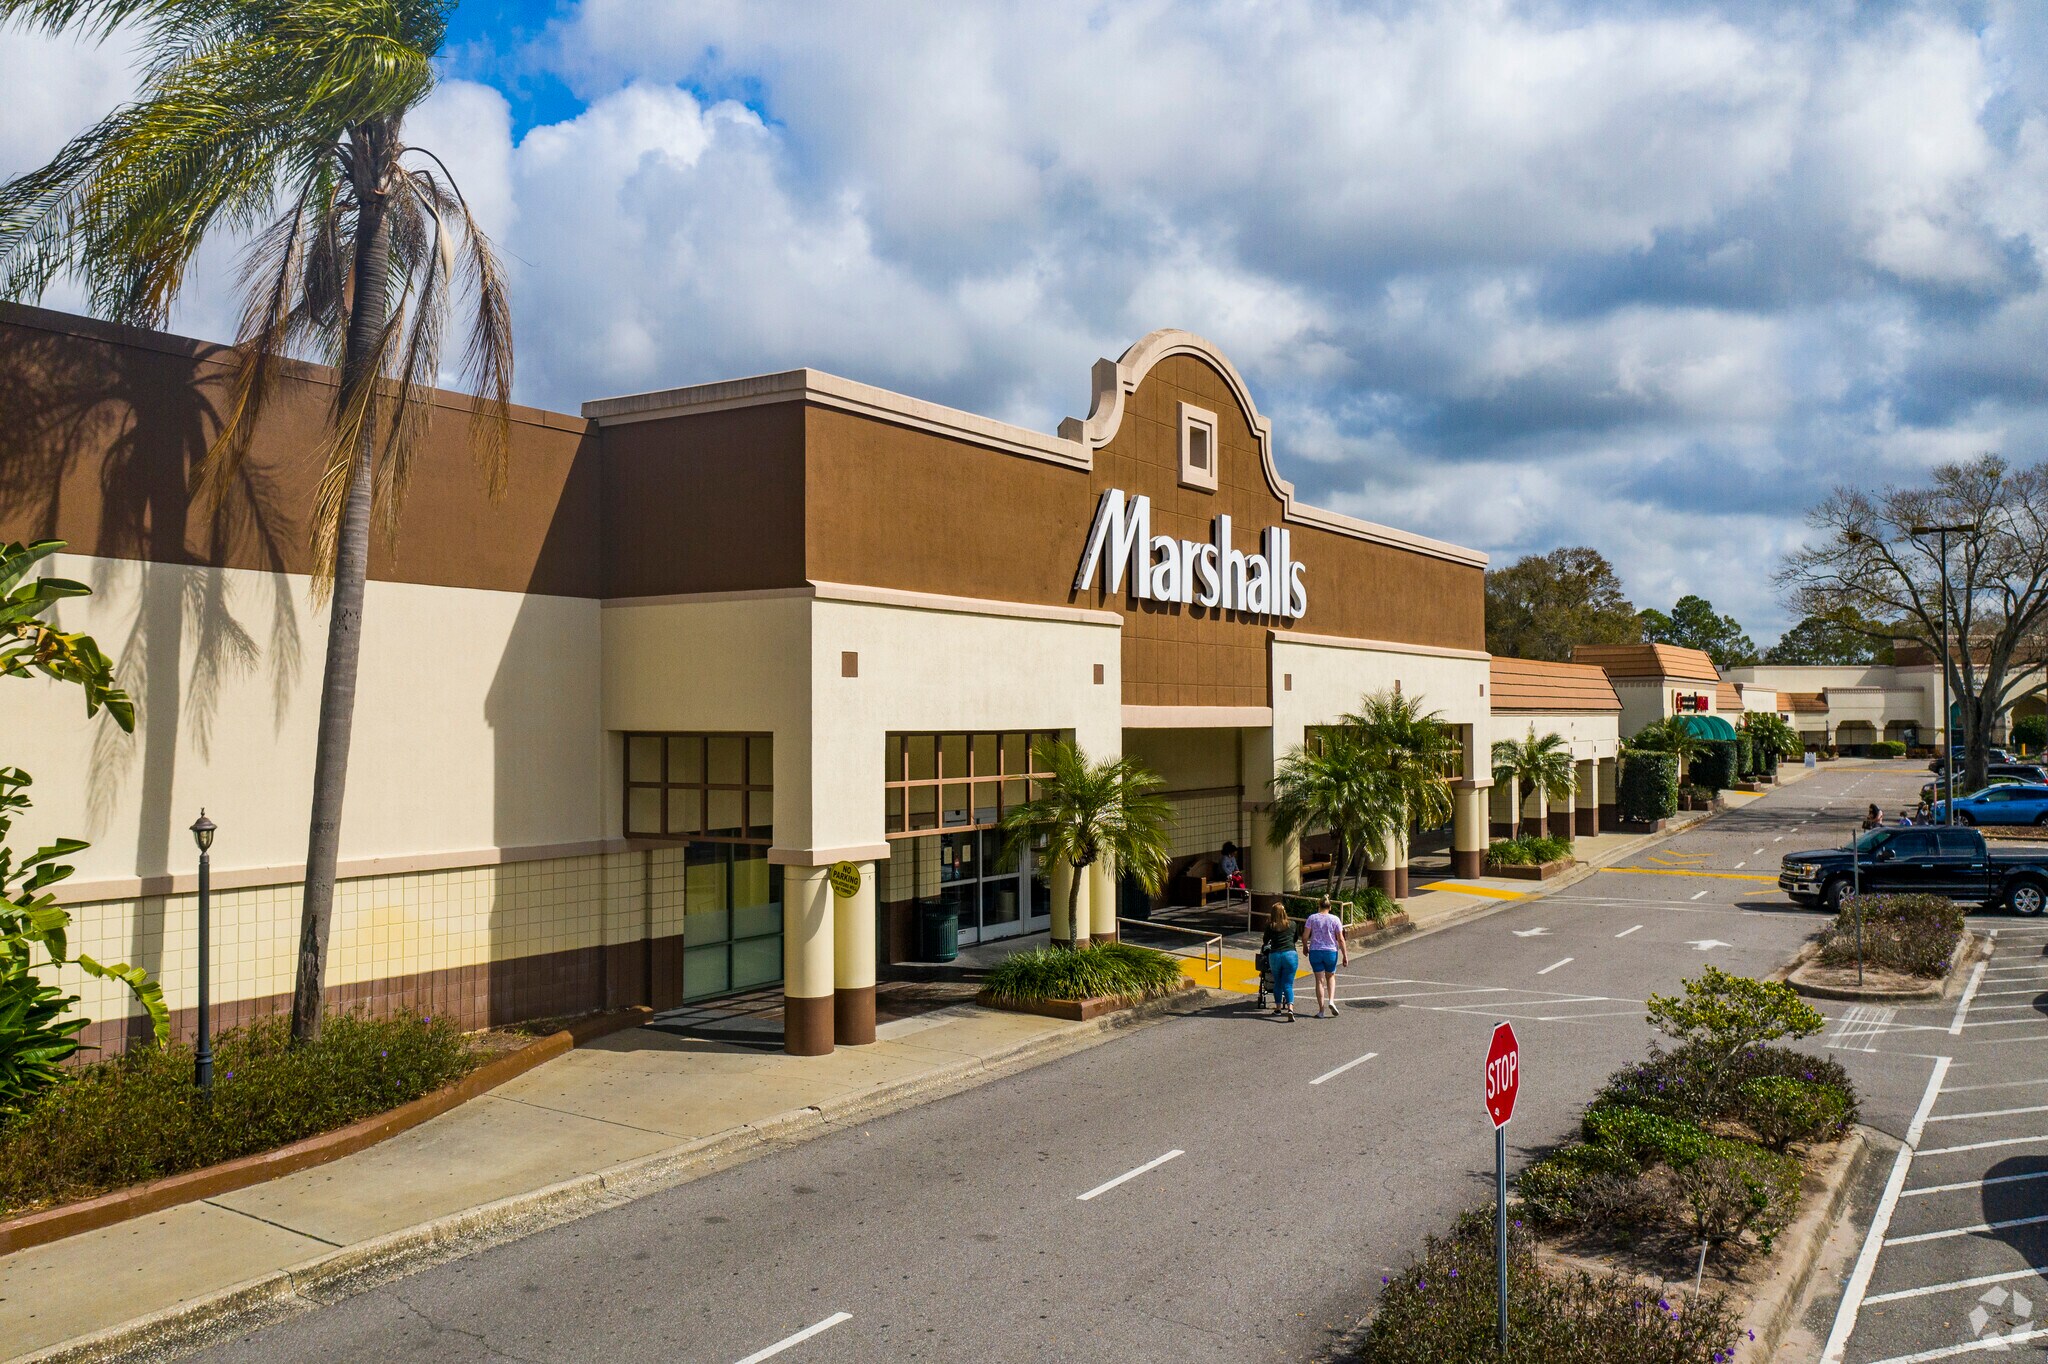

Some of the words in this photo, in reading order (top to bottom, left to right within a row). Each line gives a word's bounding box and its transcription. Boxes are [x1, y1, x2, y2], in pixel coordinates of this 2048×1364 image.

[1077, 488, 1307, 619] Marshalls
[833, 870, 858, 885] PARKING
[843, 865, 851, 874] NO
[1487, 1051, 1517, 1100] STOP
